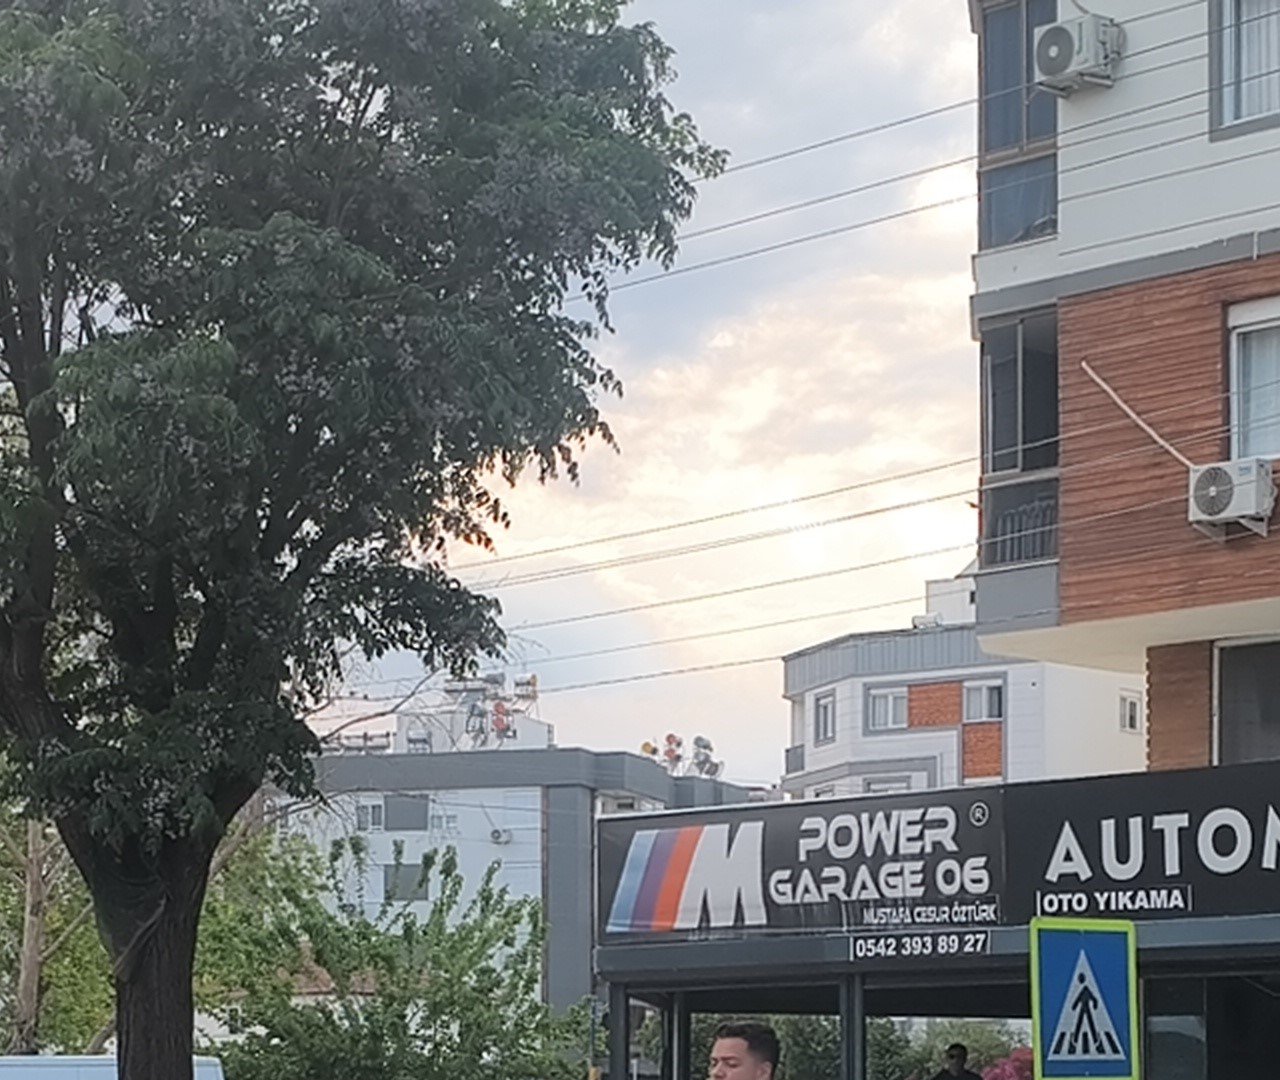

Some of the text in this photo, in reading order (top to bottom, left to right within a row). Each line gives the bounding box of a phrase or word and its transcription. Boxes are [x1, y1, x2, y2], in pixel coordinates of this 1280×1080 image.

[798, 805, 959, 861] POWER
[768, 855, 992, 905] GARAGE 06
[1042, 888, 1185, 912] OTO YIKAMA
[855, 933, 986, 958] 0542 393 89 27
